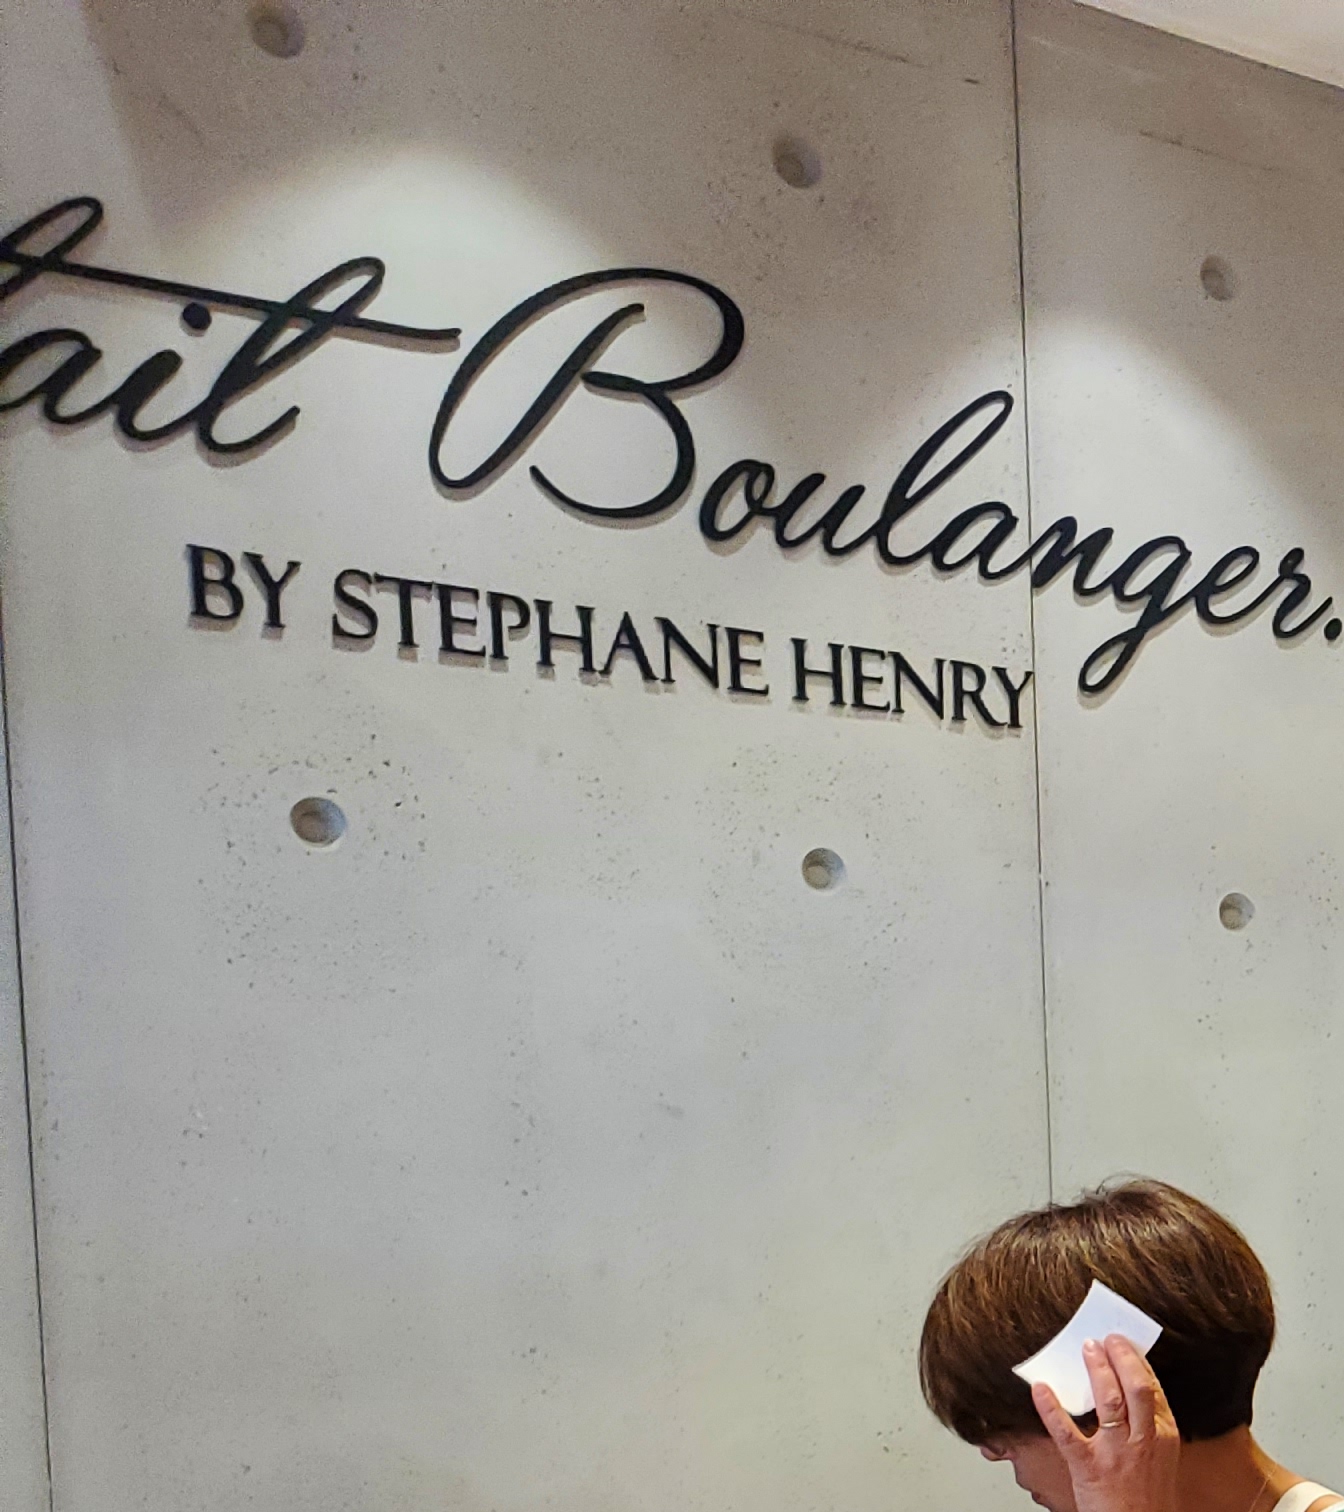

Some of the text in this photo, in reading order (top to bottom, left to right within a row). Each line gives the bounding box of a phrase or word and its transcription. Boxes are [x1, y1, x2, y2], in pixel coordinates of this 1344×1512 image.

[187, 543, 1034, 730] BY STEPHANE HENRY
